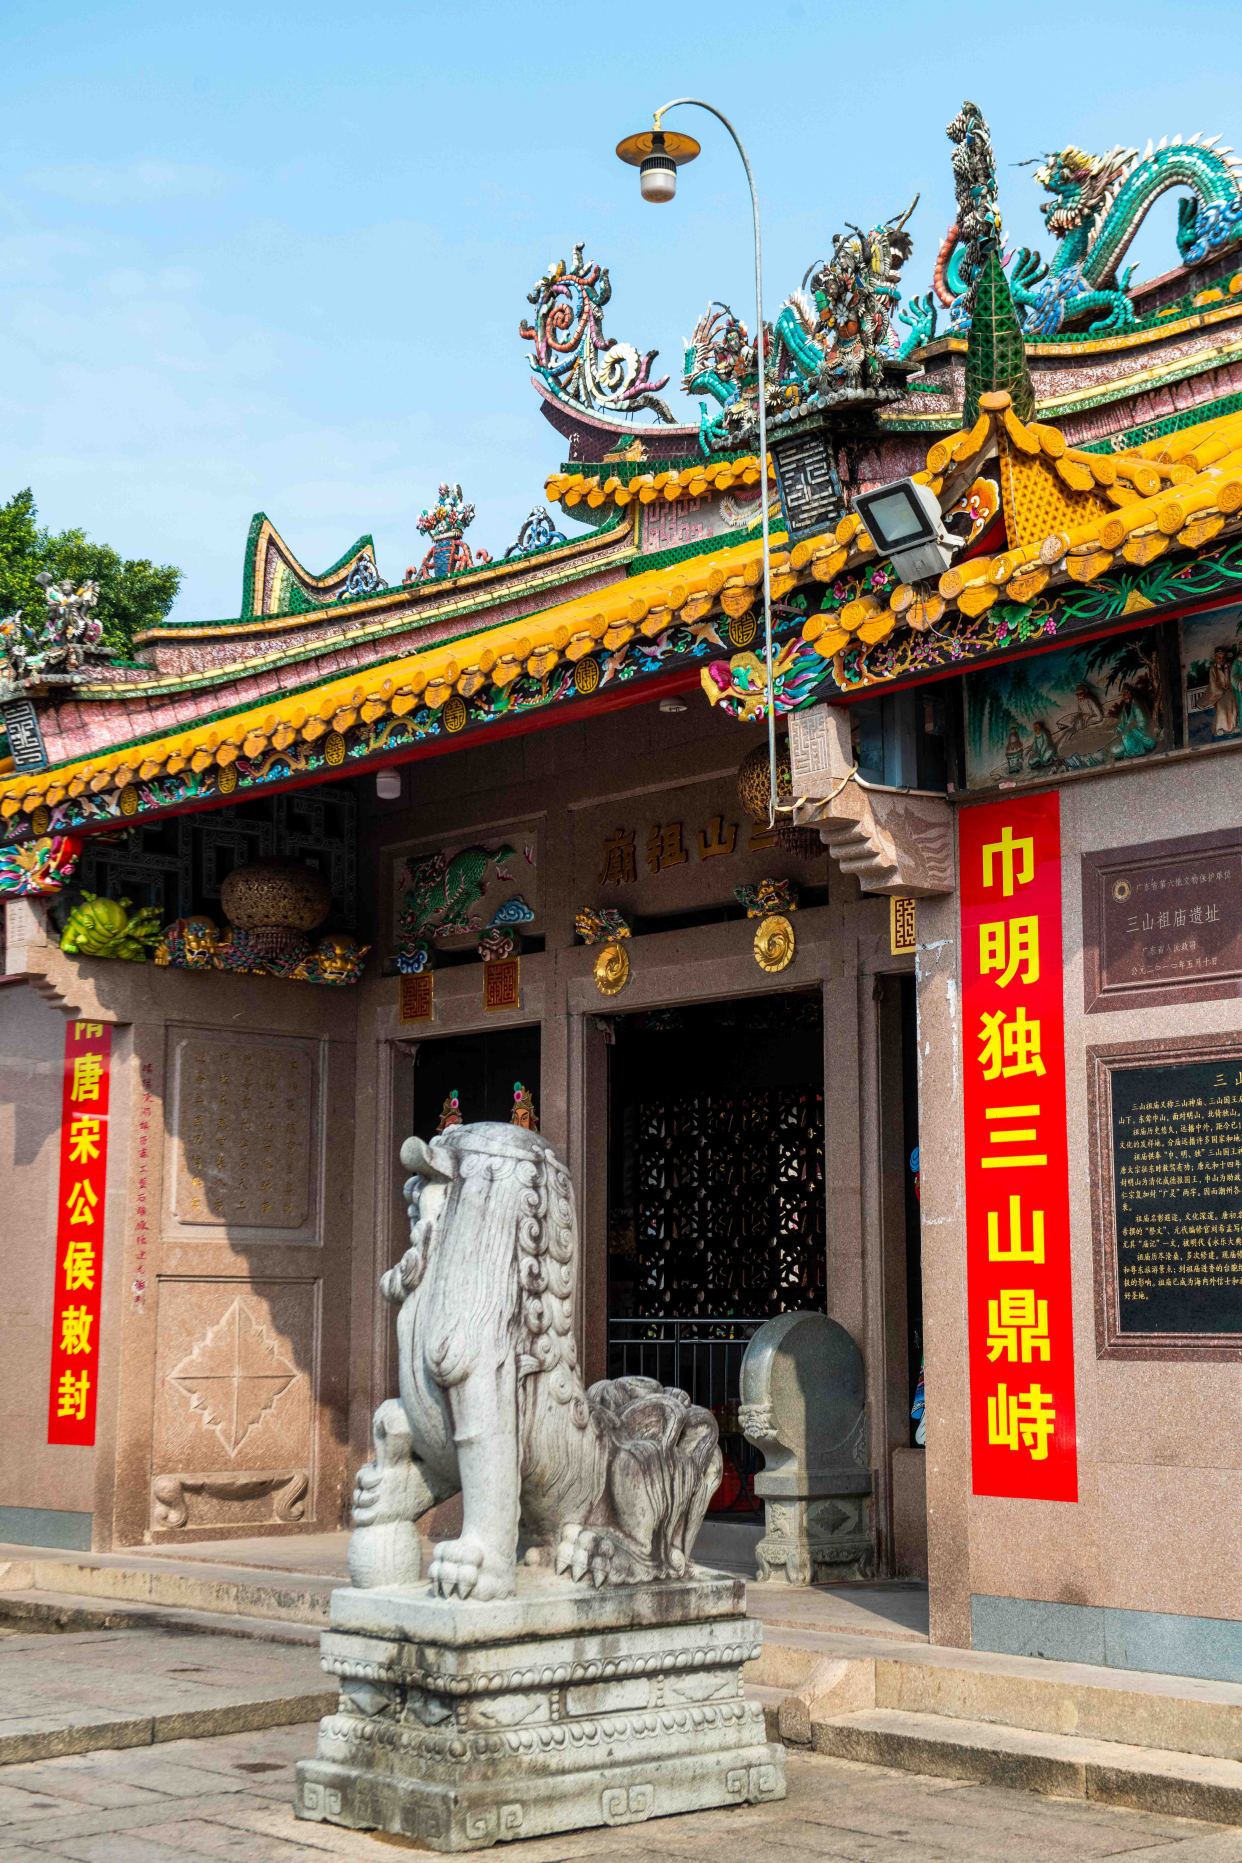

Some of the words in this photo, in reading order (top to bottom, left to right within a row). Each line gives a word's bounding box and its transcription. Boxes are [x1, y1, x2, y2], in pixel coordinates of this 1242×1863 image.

[1125, 904, 1220, 933] 三山祖庙遗址
[977, 826, 1057, 1460] 巾明独三山鼎峙
